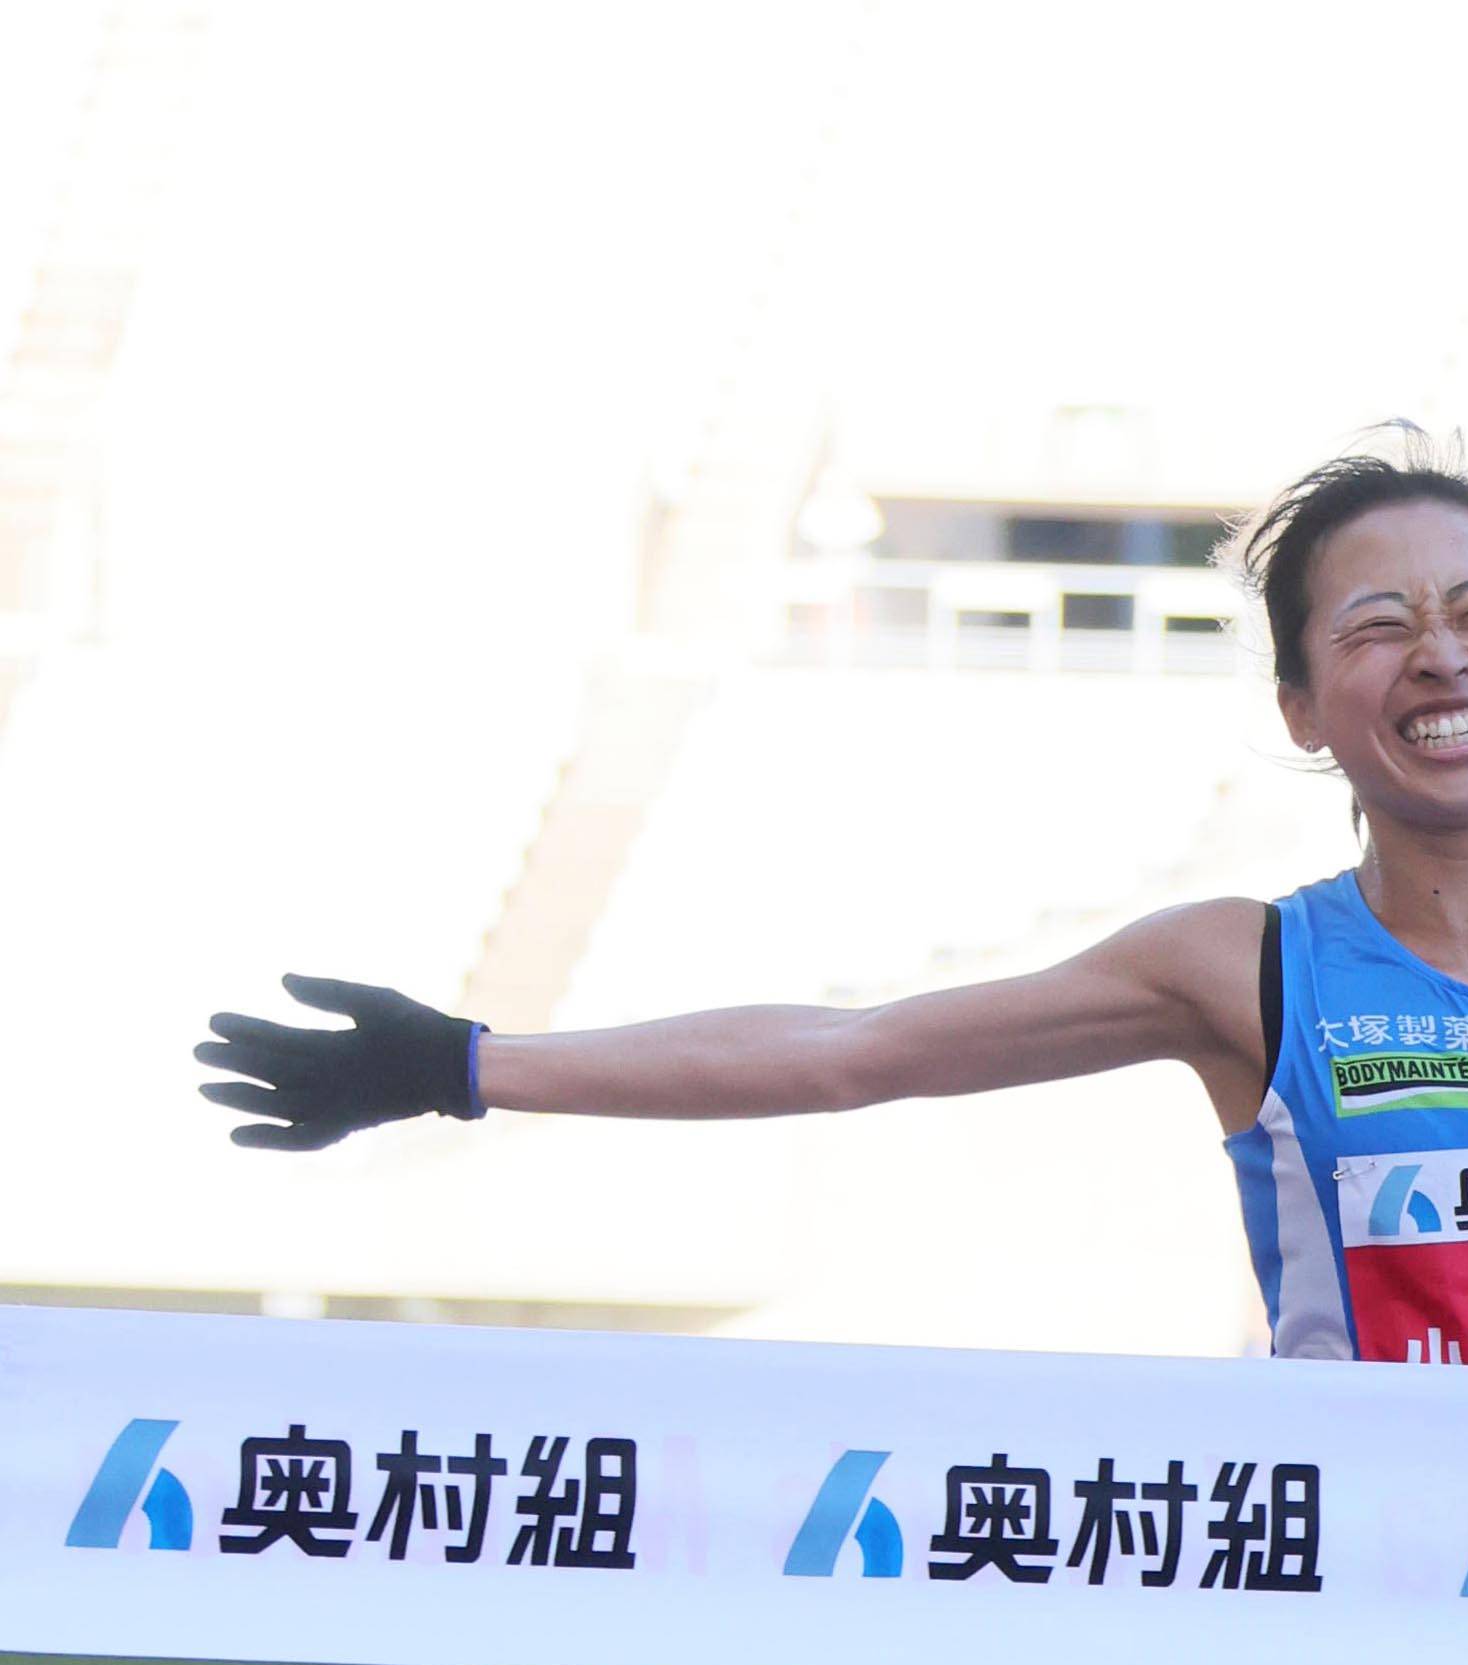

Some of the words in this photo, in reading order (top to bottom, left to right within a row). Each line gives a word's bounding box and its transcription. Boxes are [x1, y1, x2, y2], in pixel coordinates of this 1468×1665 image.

[219, 1424, 637, 1569] 奥村組
[927, 1453, 1323, 1592] 奥村組
